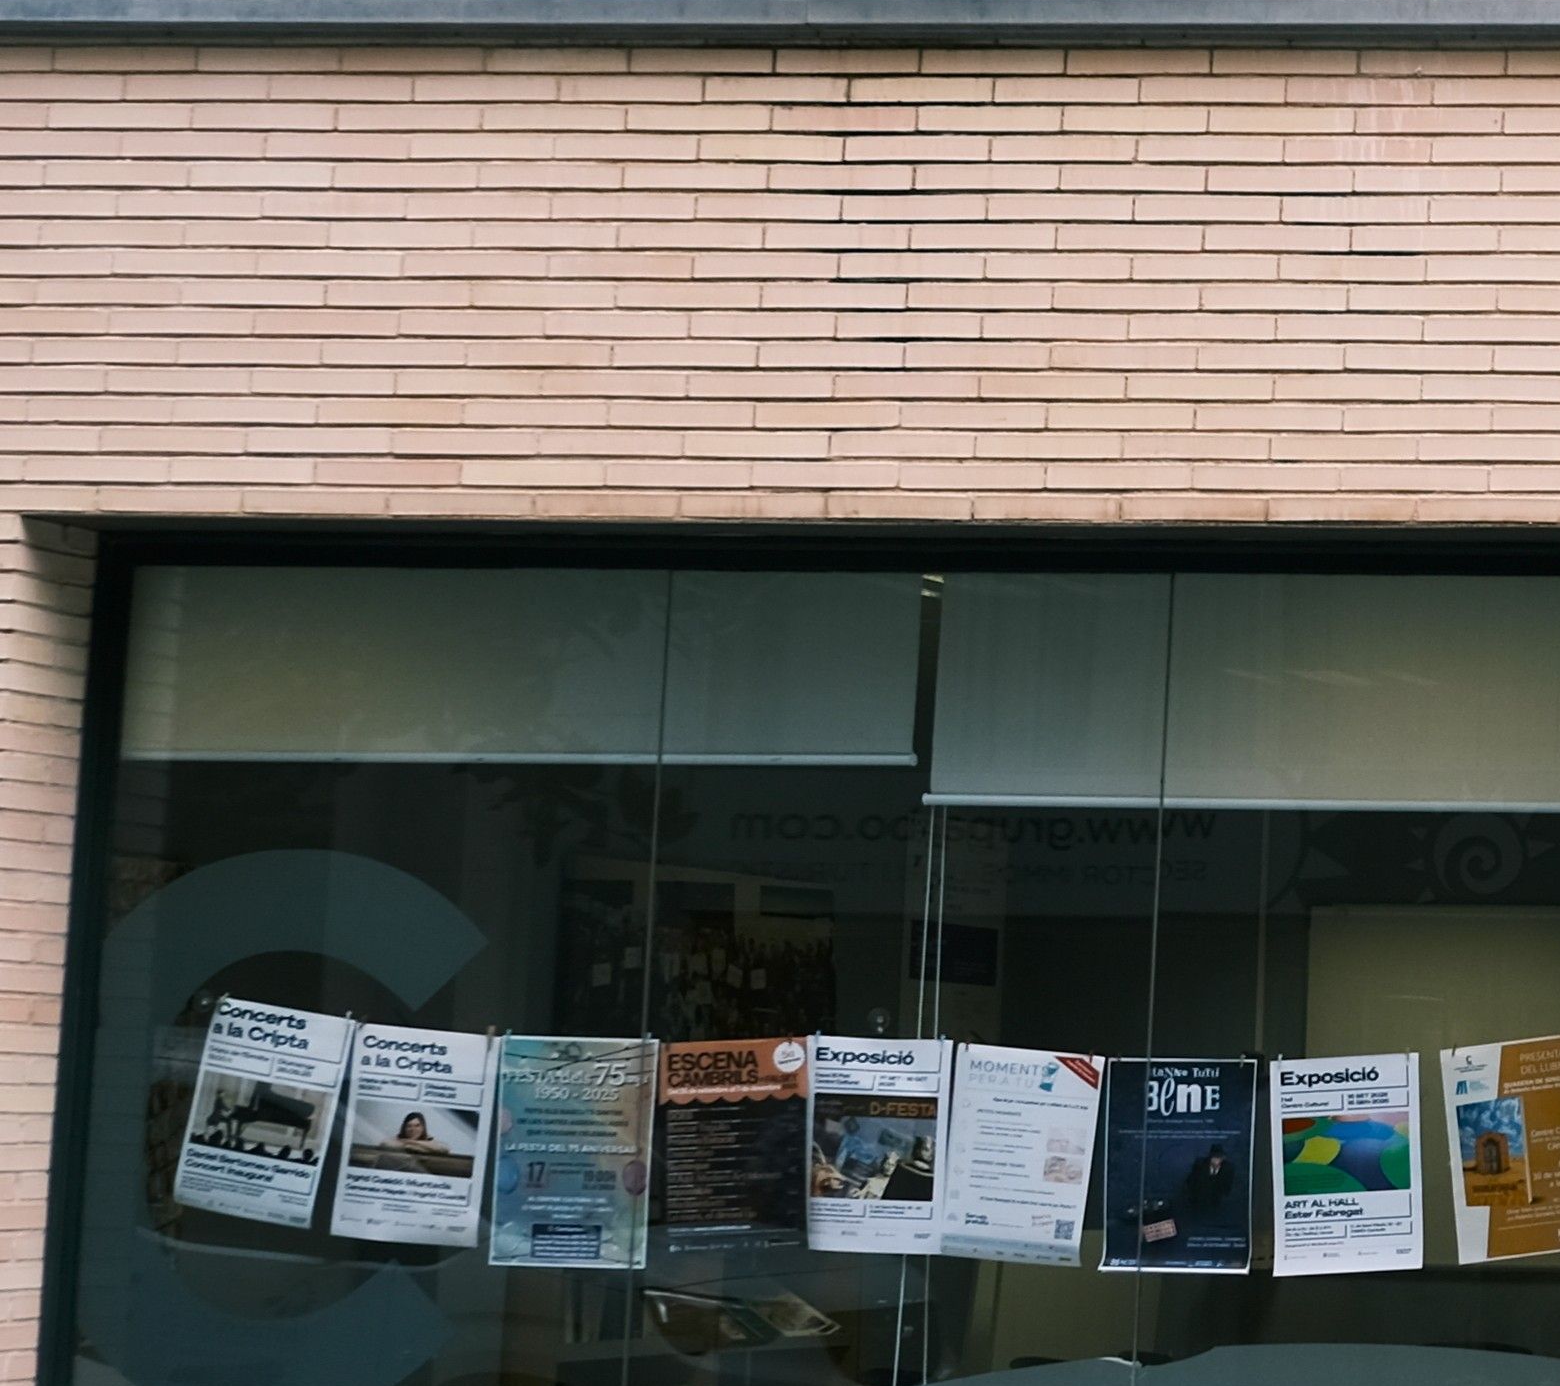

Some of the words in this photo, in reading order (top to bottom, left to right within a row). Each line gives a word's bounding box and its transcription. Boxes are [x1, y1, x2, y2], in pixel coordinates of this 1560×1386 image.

[218, 1002, 307, 1029] Concerts
[213, 1023, 223, 1034] a
[227, 1021, 244, 1038] la
[248, 1027, 310, 1050] Cripta
[363, 1035, 448, 1056] Concerts
[361, 1056, 371, 1066] a
[376, 1054, 391, 1067] la
[396, 1056, 453, 1075] Cripta
[668, 1051, 758, 1071] ESCENA
[816, 1046, 914, 1065] Exposició
[668, 1070, 758, 1087] CAMBRILS
[1280, 1067, 1379, 1087] Exposició
[1285, 1201, 1307, 1209] ART
[1311, 1200, 1325, 1208] AL
[1329, 1199, 1359, 1207] HALL
[1285, 1210, 1313, 1220] Ester
